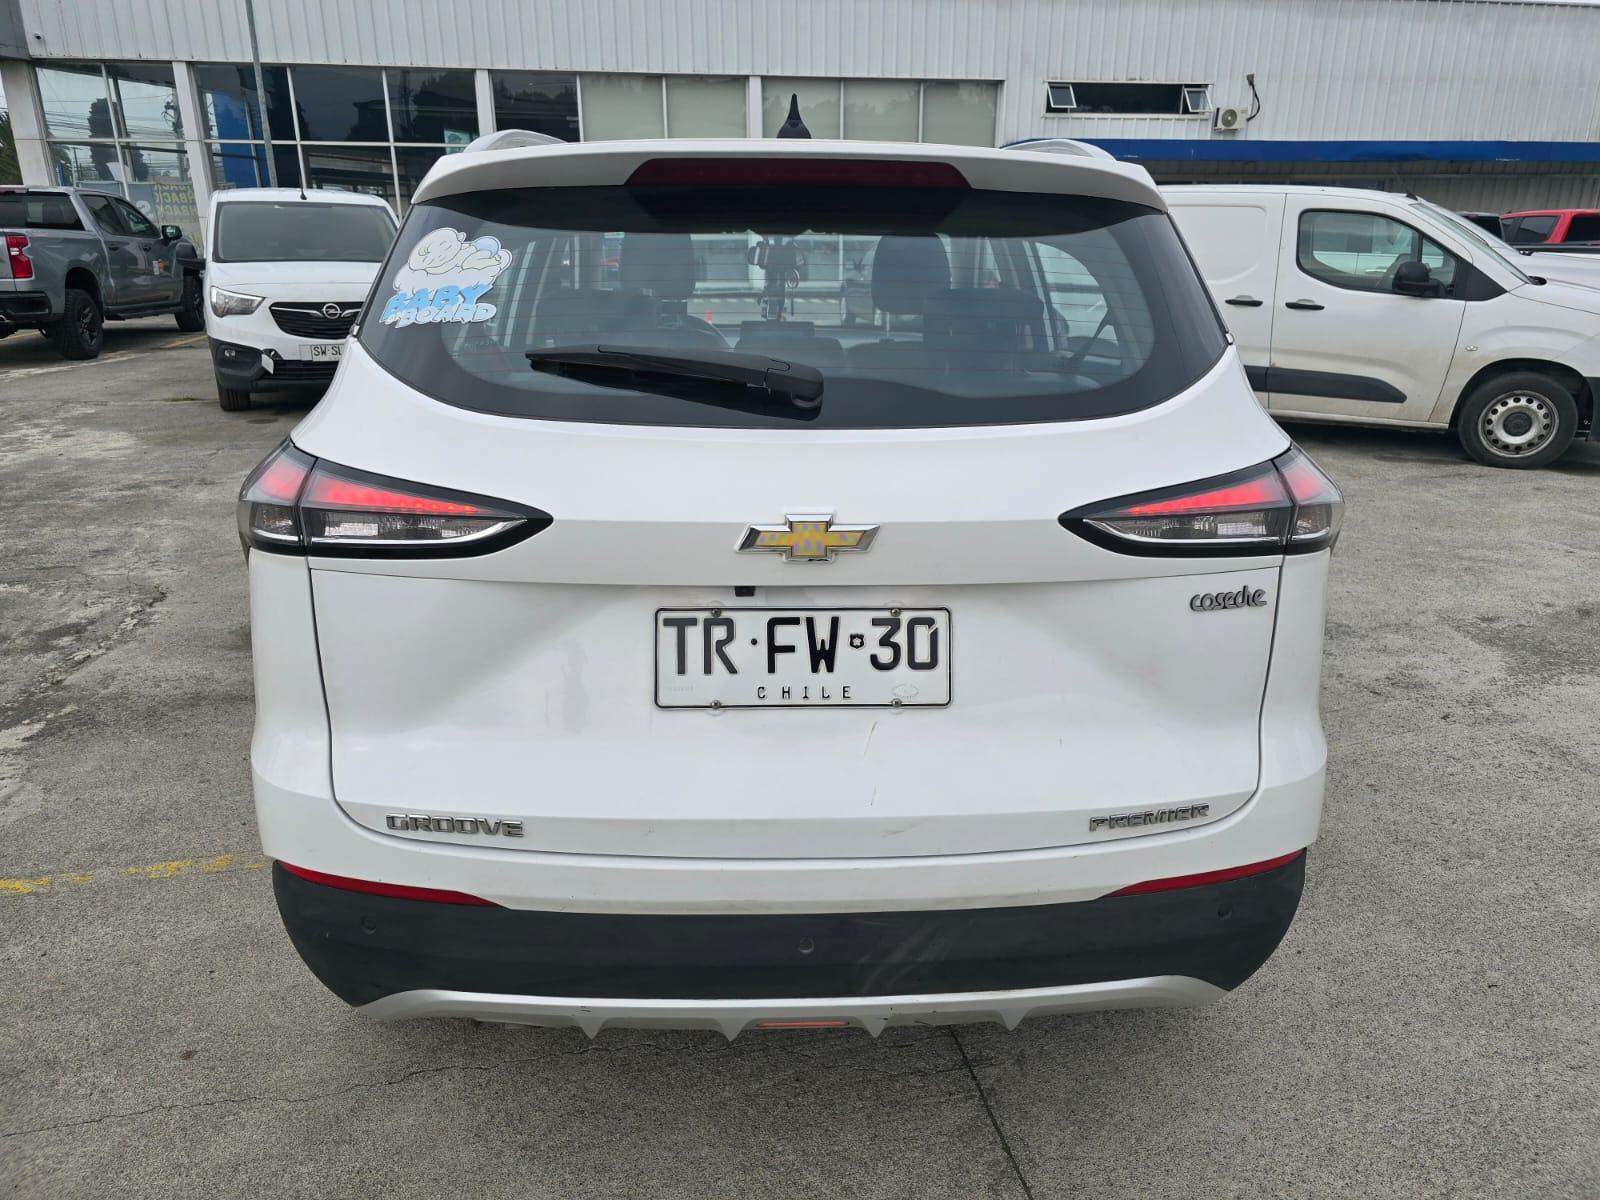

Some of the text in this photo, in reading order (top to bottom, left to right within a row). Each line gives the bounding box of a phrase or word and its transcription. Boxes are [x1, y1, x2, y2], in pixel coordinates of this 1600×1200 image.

[380, 284, 493, 321] BABY
[1190, 585, 1267, 612] coseche
[757, 685, 852, 700] CHILE
[385, 813, 524, 838] GROOVE
[1089, 802, 1209, 832] PREMIER
